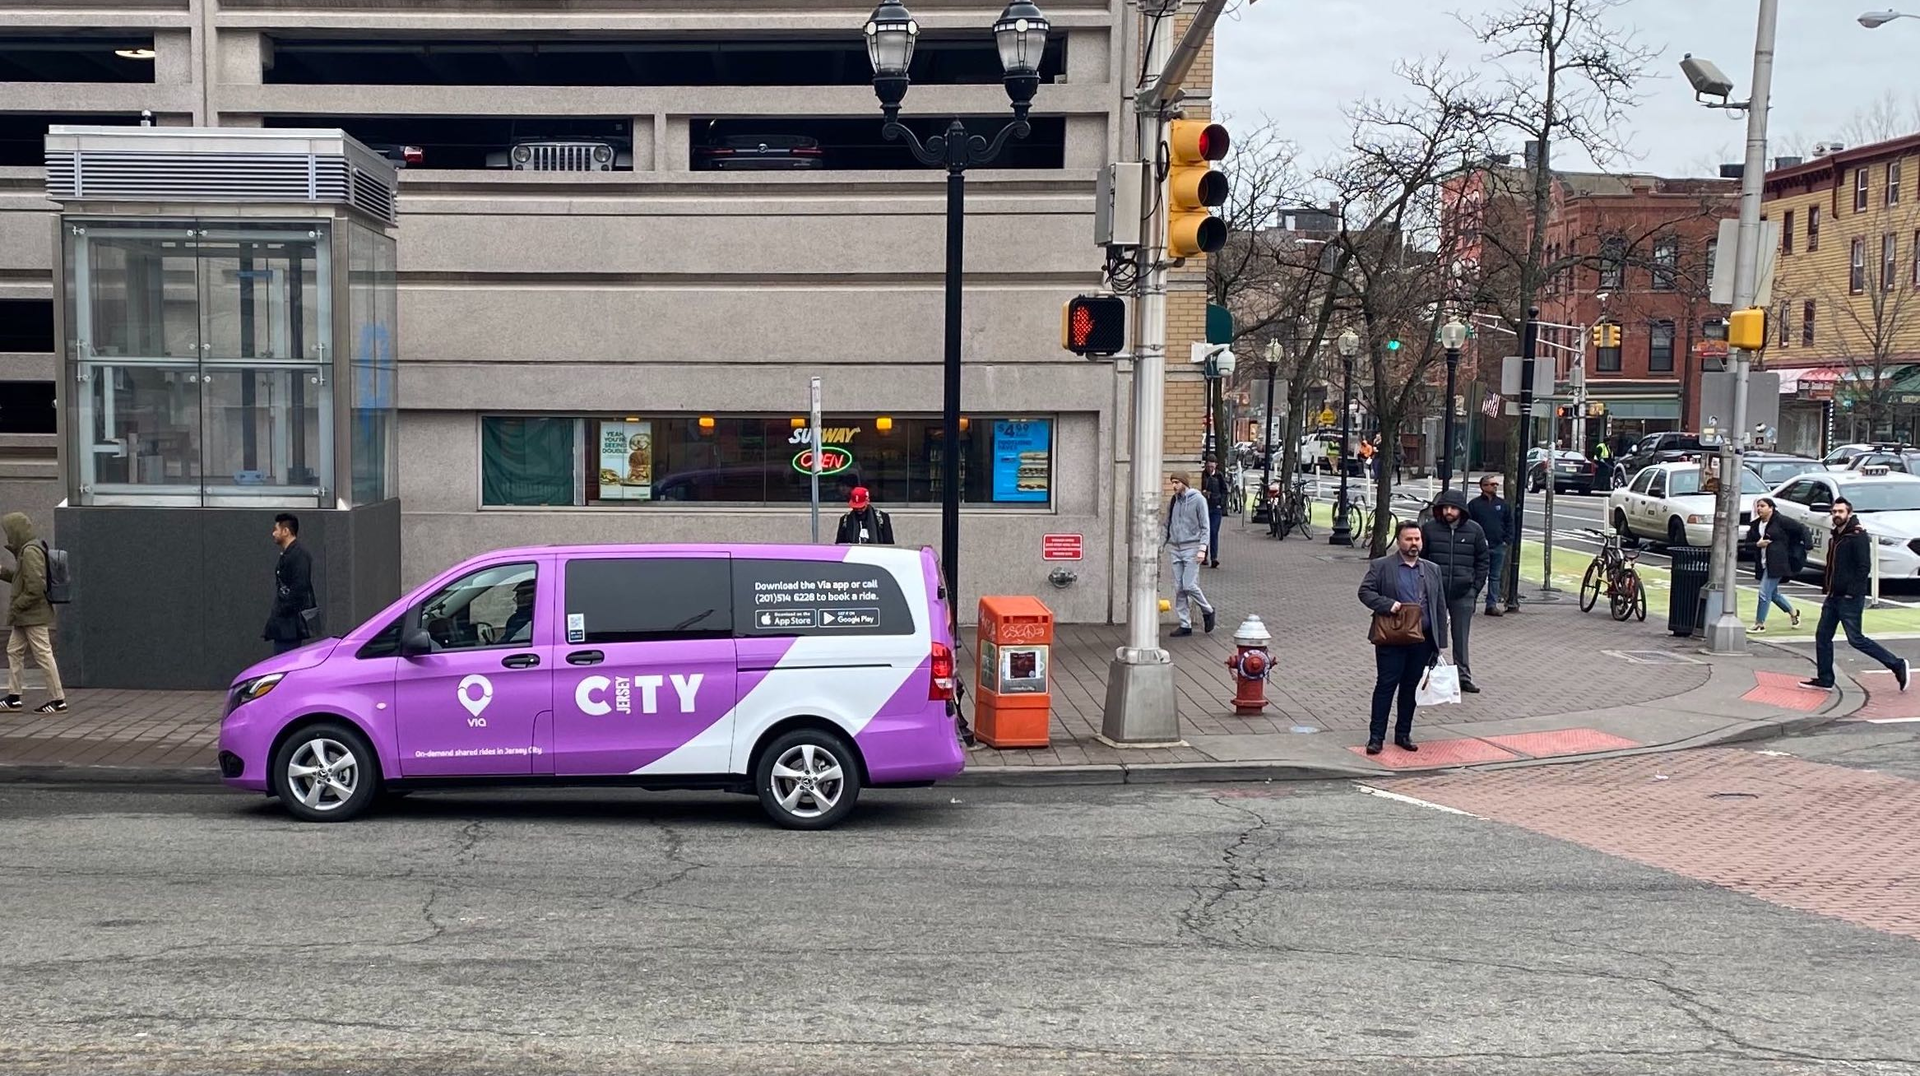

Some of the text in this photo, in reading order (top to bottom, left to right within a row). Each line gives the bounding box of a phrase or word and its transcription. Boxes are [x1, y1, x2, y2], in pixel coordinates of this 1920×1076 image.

[788, 426, 861, 444] SUWAY
[800, 453, 845, 469] OEN
[755, 581, 799, 590] Download
[800, 581, 815, 590] the
[816, 580, 831, 589] Via
[833, 582, 849, 591] app
[862, 580, 878, 588] call
[755, 593, 791, 604] (201)514
[794, 593, 815, 601] 6228
[816, 593, 827, 601] to
[828, 592, 850, 601] book
[859, 591, 879, 600] ride.
[837, 616, 860, 624] Google
[615, 676, 631, 714] JERSEY
[415, 749, 454, 757] On-demand
[455, 748, 478, 756] shared
[479, 747, 496, 755] rides
[497, 747, 504, 755] in
[504, 747, 527, 756] Jersey
